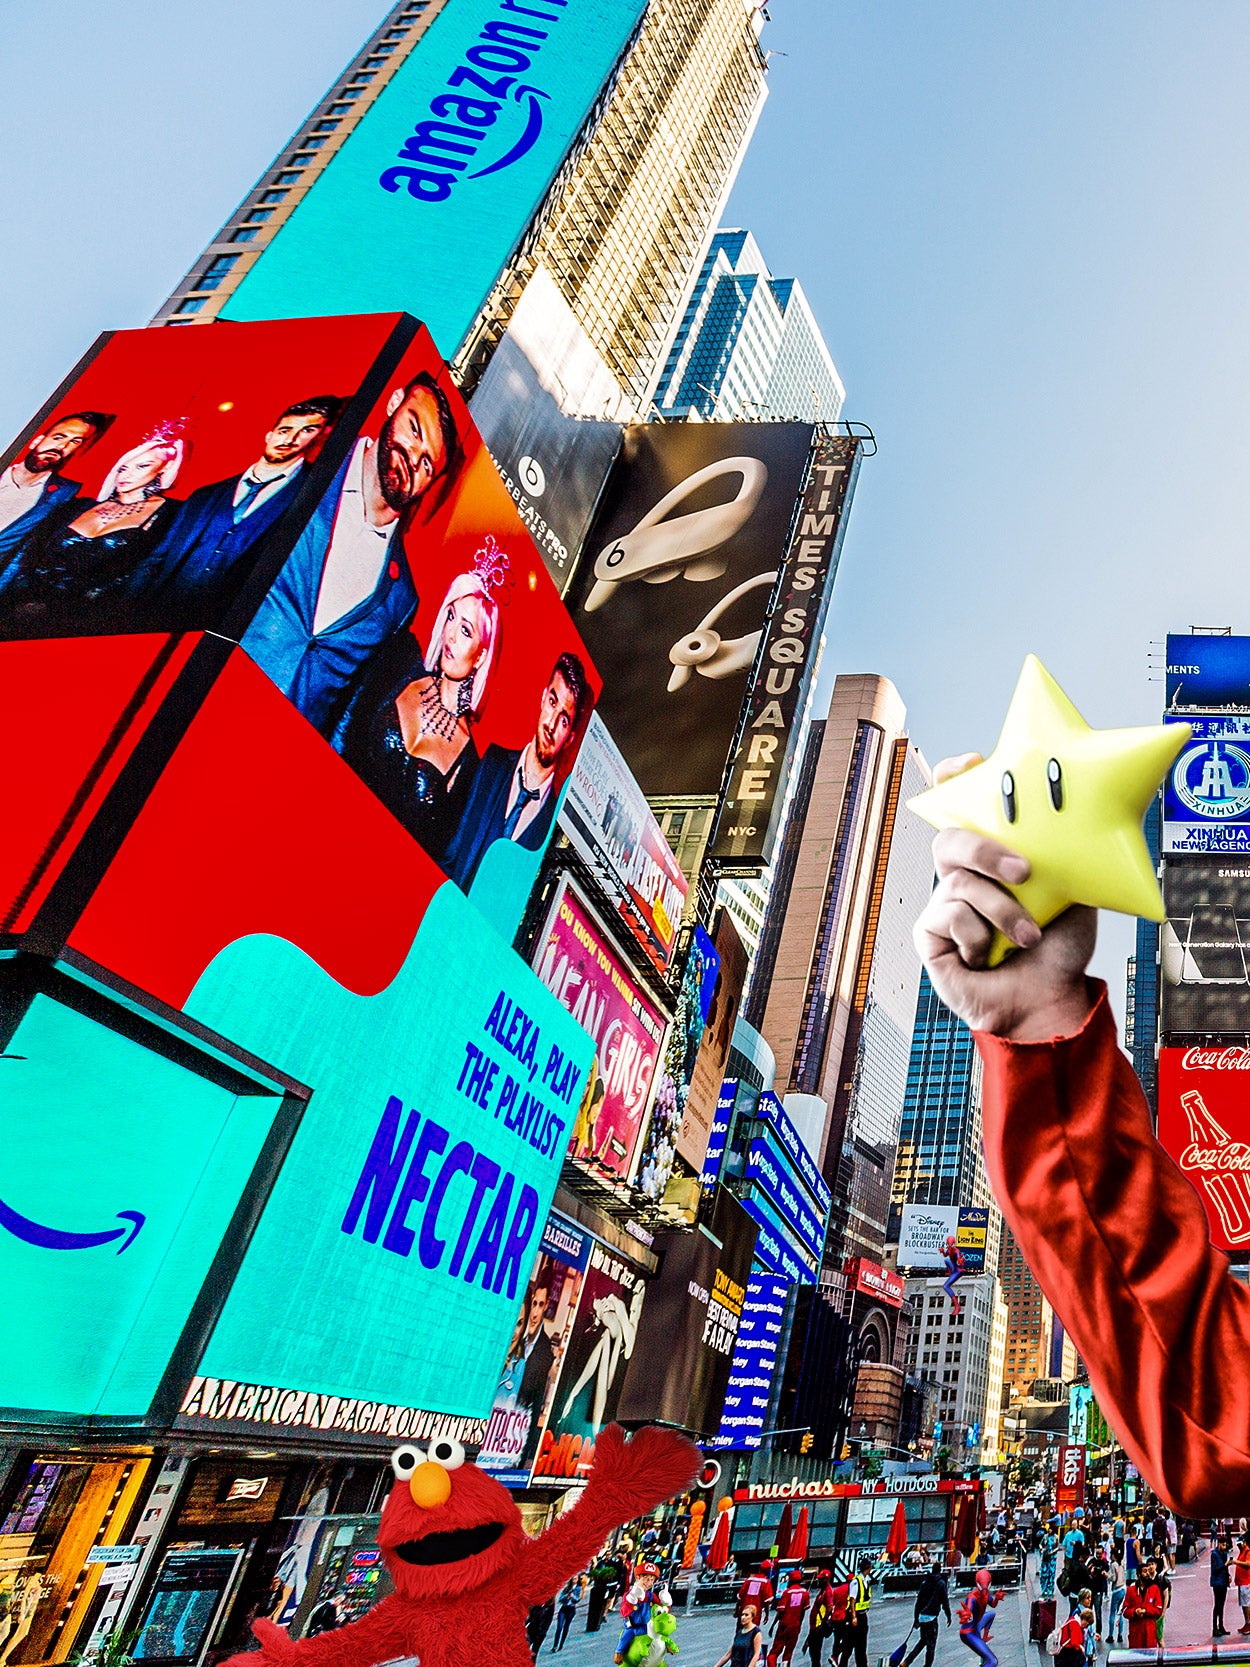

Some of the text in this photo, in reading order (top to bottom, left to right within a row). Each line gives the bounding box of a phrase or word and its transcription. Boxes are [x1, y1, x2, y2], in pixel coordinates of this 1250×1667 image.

[380, 21, 531, 202] amazon
[545, 529, 568, 560] PRO
[736, 465, 846, 800] TIMES SQUARE
[575, 765, 602, 818] WRONG
[1193, 801, 1245, 816] XINHUA
[727, 825, 757, 837] NYC
[1172, 841, 1208, 851] NEWS
[1186, 828, 1247, 841] XINHUA
[573, 919, 598, 957] KNOW
[597, 949, 612, 976] YOU
[484, 990, 581, 1104] ALEXA, PLAY
[600, 1018, 652, 1118] GIRLS
[456, 1041, 565, 1160] THE PLAYLIST
[341, 1095, 539, 1300] NECTAR
[544, 1225, 581, 1257] BAREILLES
[911, 1232, 945, 1240] BROADWAY
[957, 1236, 970, 1244] LION
[180, 1376, 487, 1445] AMERICAN EAGLE OUTFITTERS
[1064, 1448, 1082, 1486] tkts
[748, 1476, 835, 1499] nuchas
[862, 1477, 938, 1494] NY HOTDOGS
